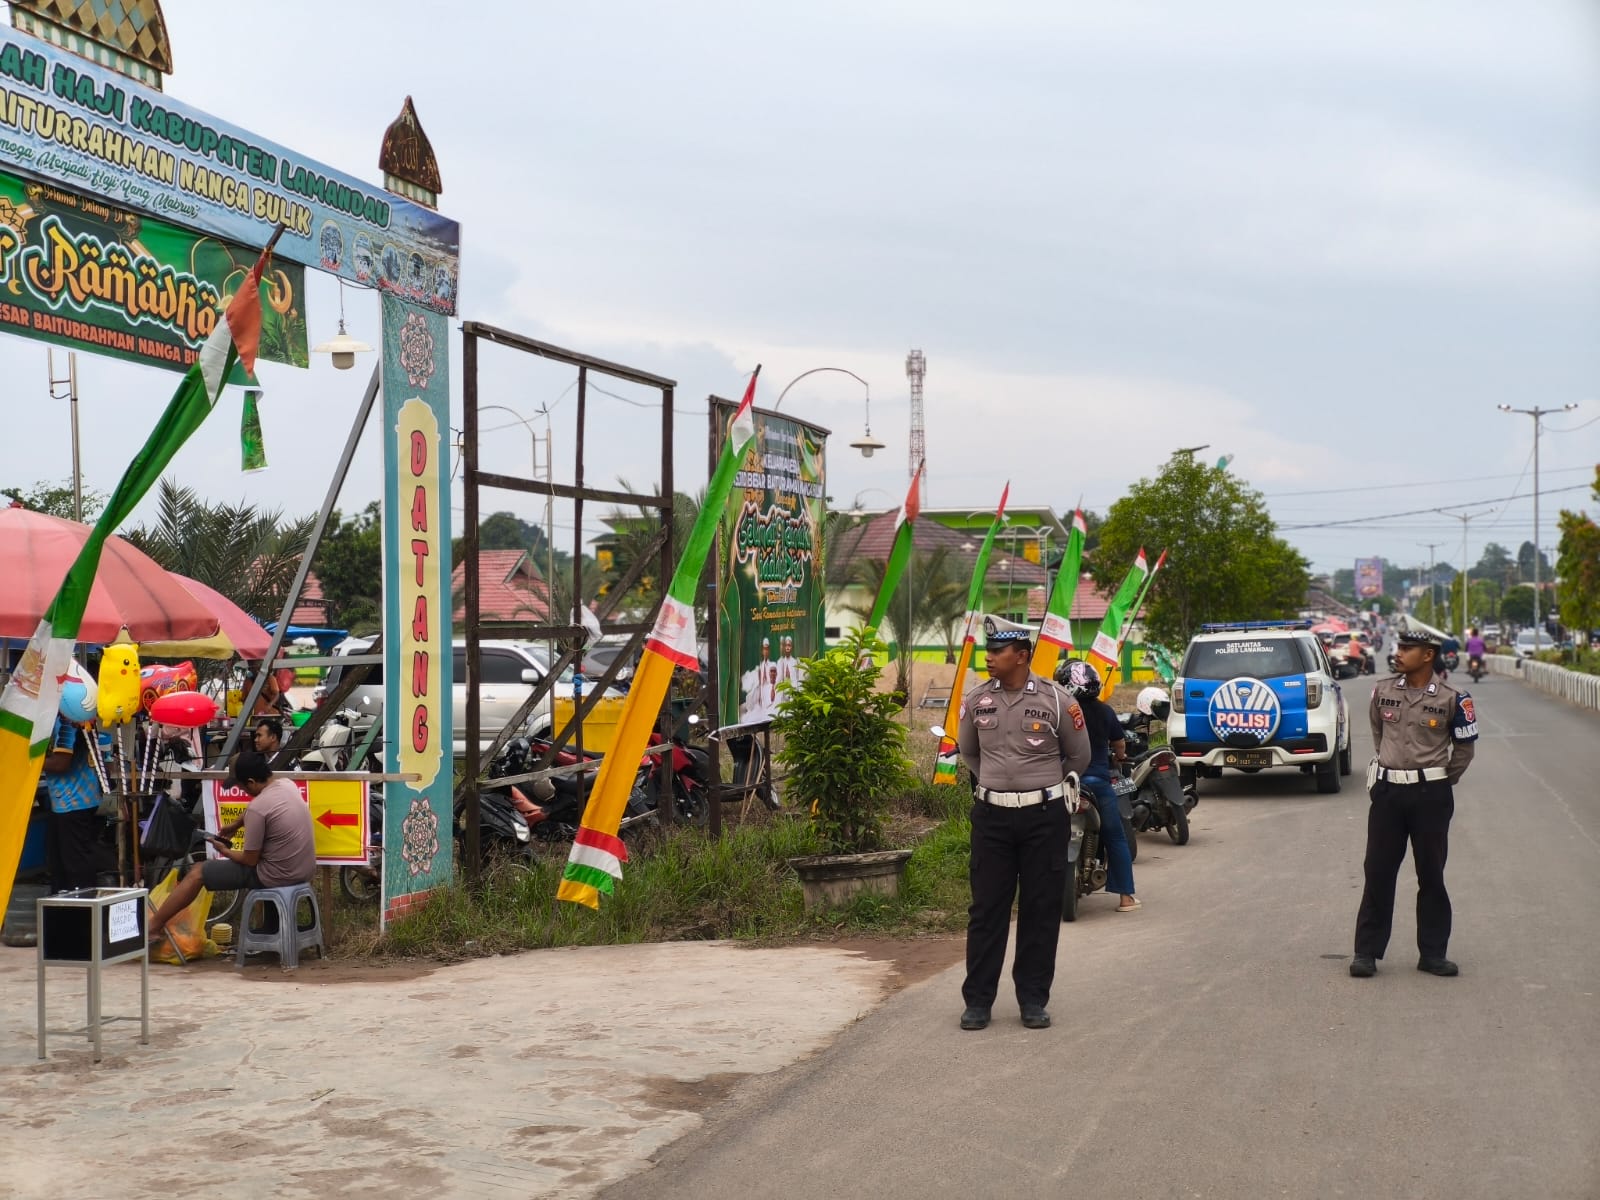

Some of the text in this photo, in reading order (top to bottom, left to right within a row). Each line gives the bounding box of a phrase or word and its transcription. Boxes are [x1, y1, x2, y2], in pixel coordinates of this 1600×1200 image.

[52, 62, 126, 122] HAJI
[130, 95, 277, 183] KABUPATEN
[281, 159, 390, 228] LAMANDAU
[36, 151, 88, 178] Menjadi
[90, 169, 118, 190] Haji
[120, 179, 150, 208] Yang
[44, 184, 77, 208] Selamat
[81, 198, 110, 222] Datang
[179, 159, 250, 213] NANGA
[253, 187, 312, 235] BULIK
[33, 313, 135, 351] BAITURRAHMAN
[138, 336, 181, 362] NANGA
[410, 429, 429, 753] DATANG
[1024, 709, 1050, 720] POLRI
[1216, 712, 1271, 728] POLISI
[1423, 705, 1447, 715] POLRI
